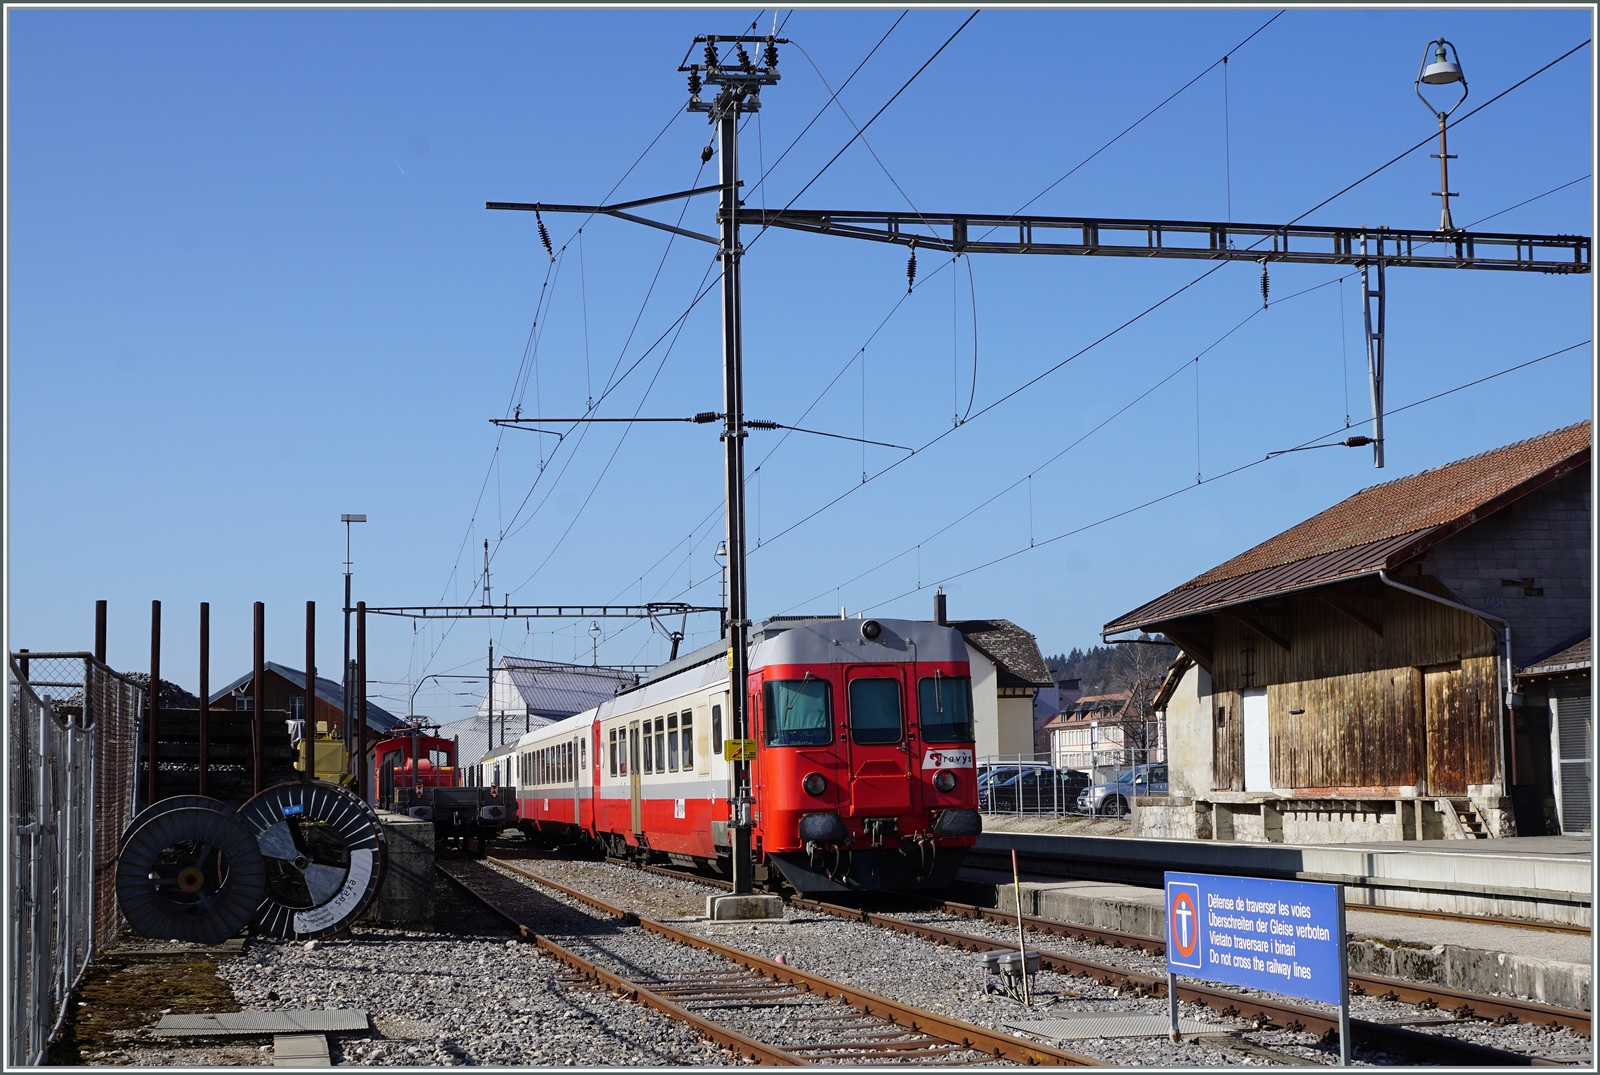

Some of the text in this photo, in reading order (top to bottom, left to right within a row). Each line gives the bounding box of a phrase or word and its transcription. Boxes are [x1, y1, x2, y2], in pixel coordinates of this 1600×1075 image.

[1208, 893, 1311, 918] Défense de traverser les voies
[1209, 909, 1329, 941] Überschreiten der Gleise verboten
[1209, 930, 1295, 956] Vietato traversare i binari
[1210, 949, 1311, 980] Do not cross the railway lines
